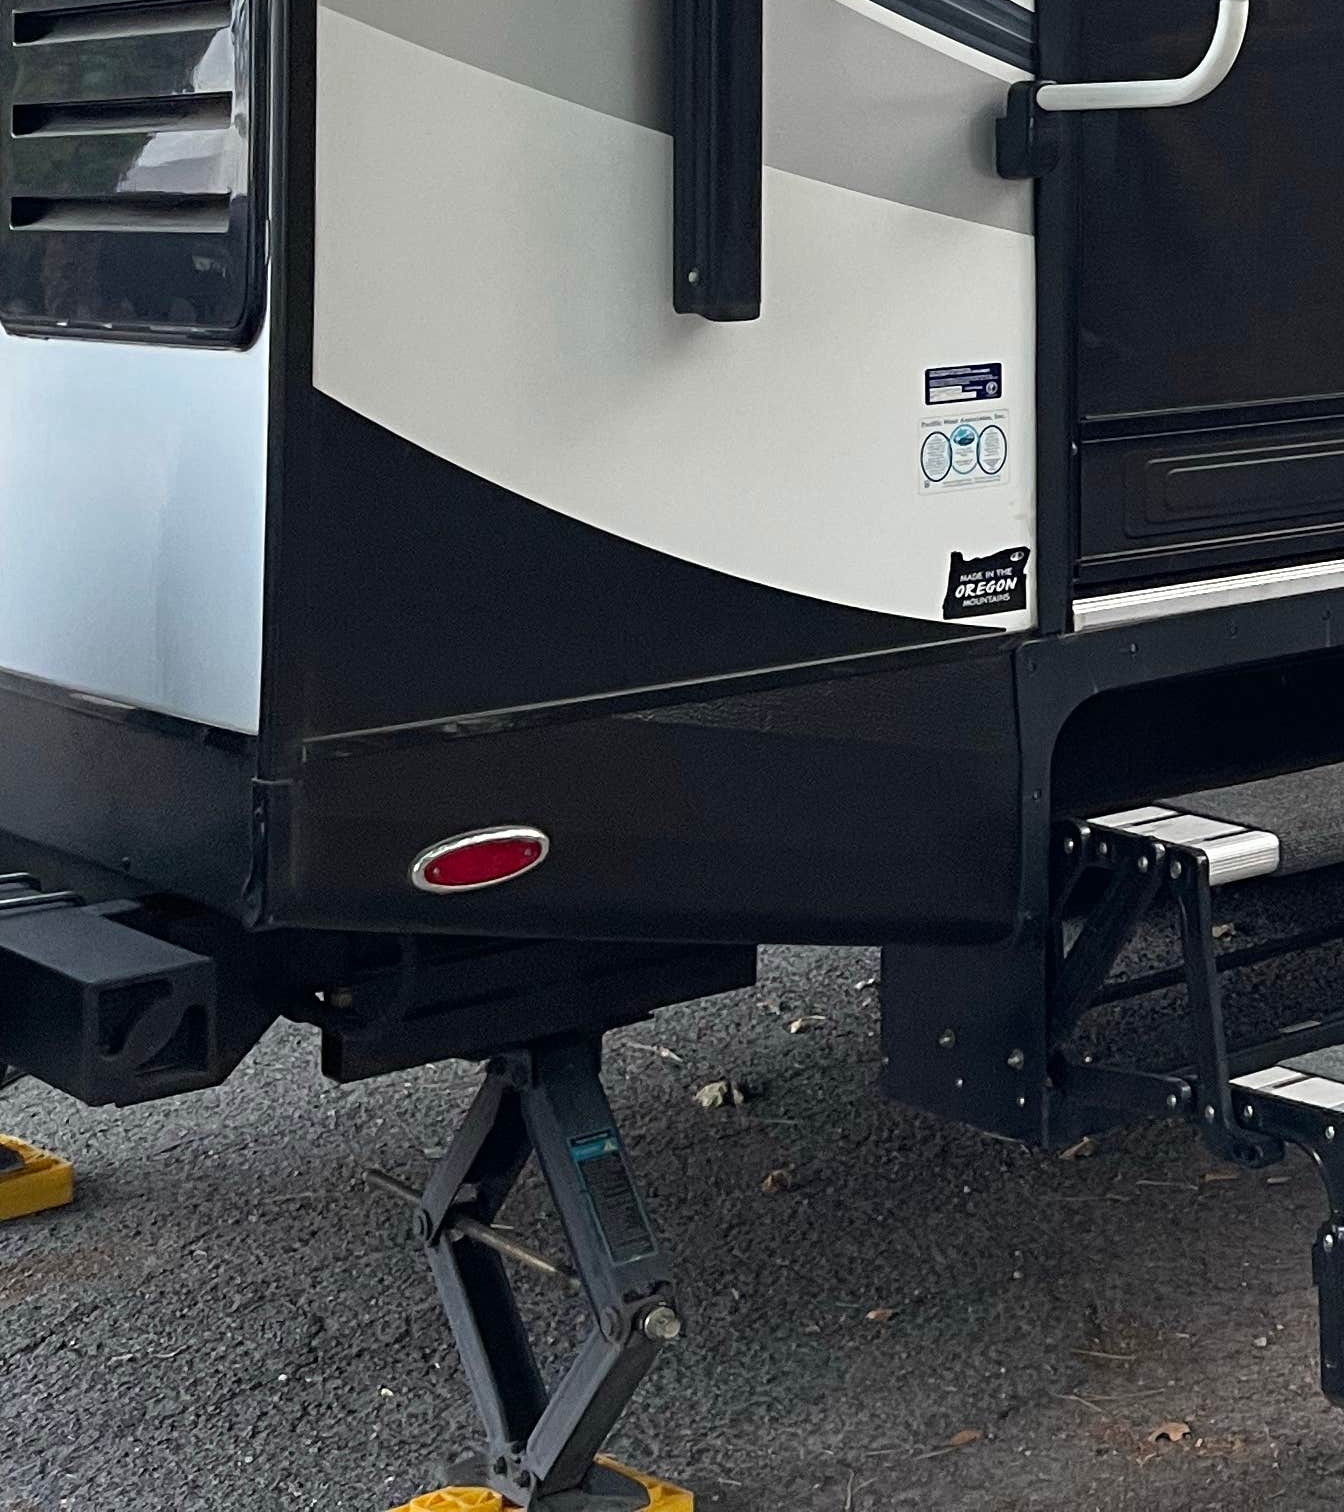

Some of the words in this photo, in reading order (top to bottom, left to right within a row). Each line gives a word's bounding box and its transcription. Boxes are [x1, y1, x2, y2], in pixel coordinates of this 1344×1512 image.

[960, 571, 983, 582] MADE
[985, 569, 995, 579] IN
[996, 567, 1013, 577] THE
[954, 576, 1018, 599] OREGON
[962, 592, 1011, 608] MOUNTAINS
